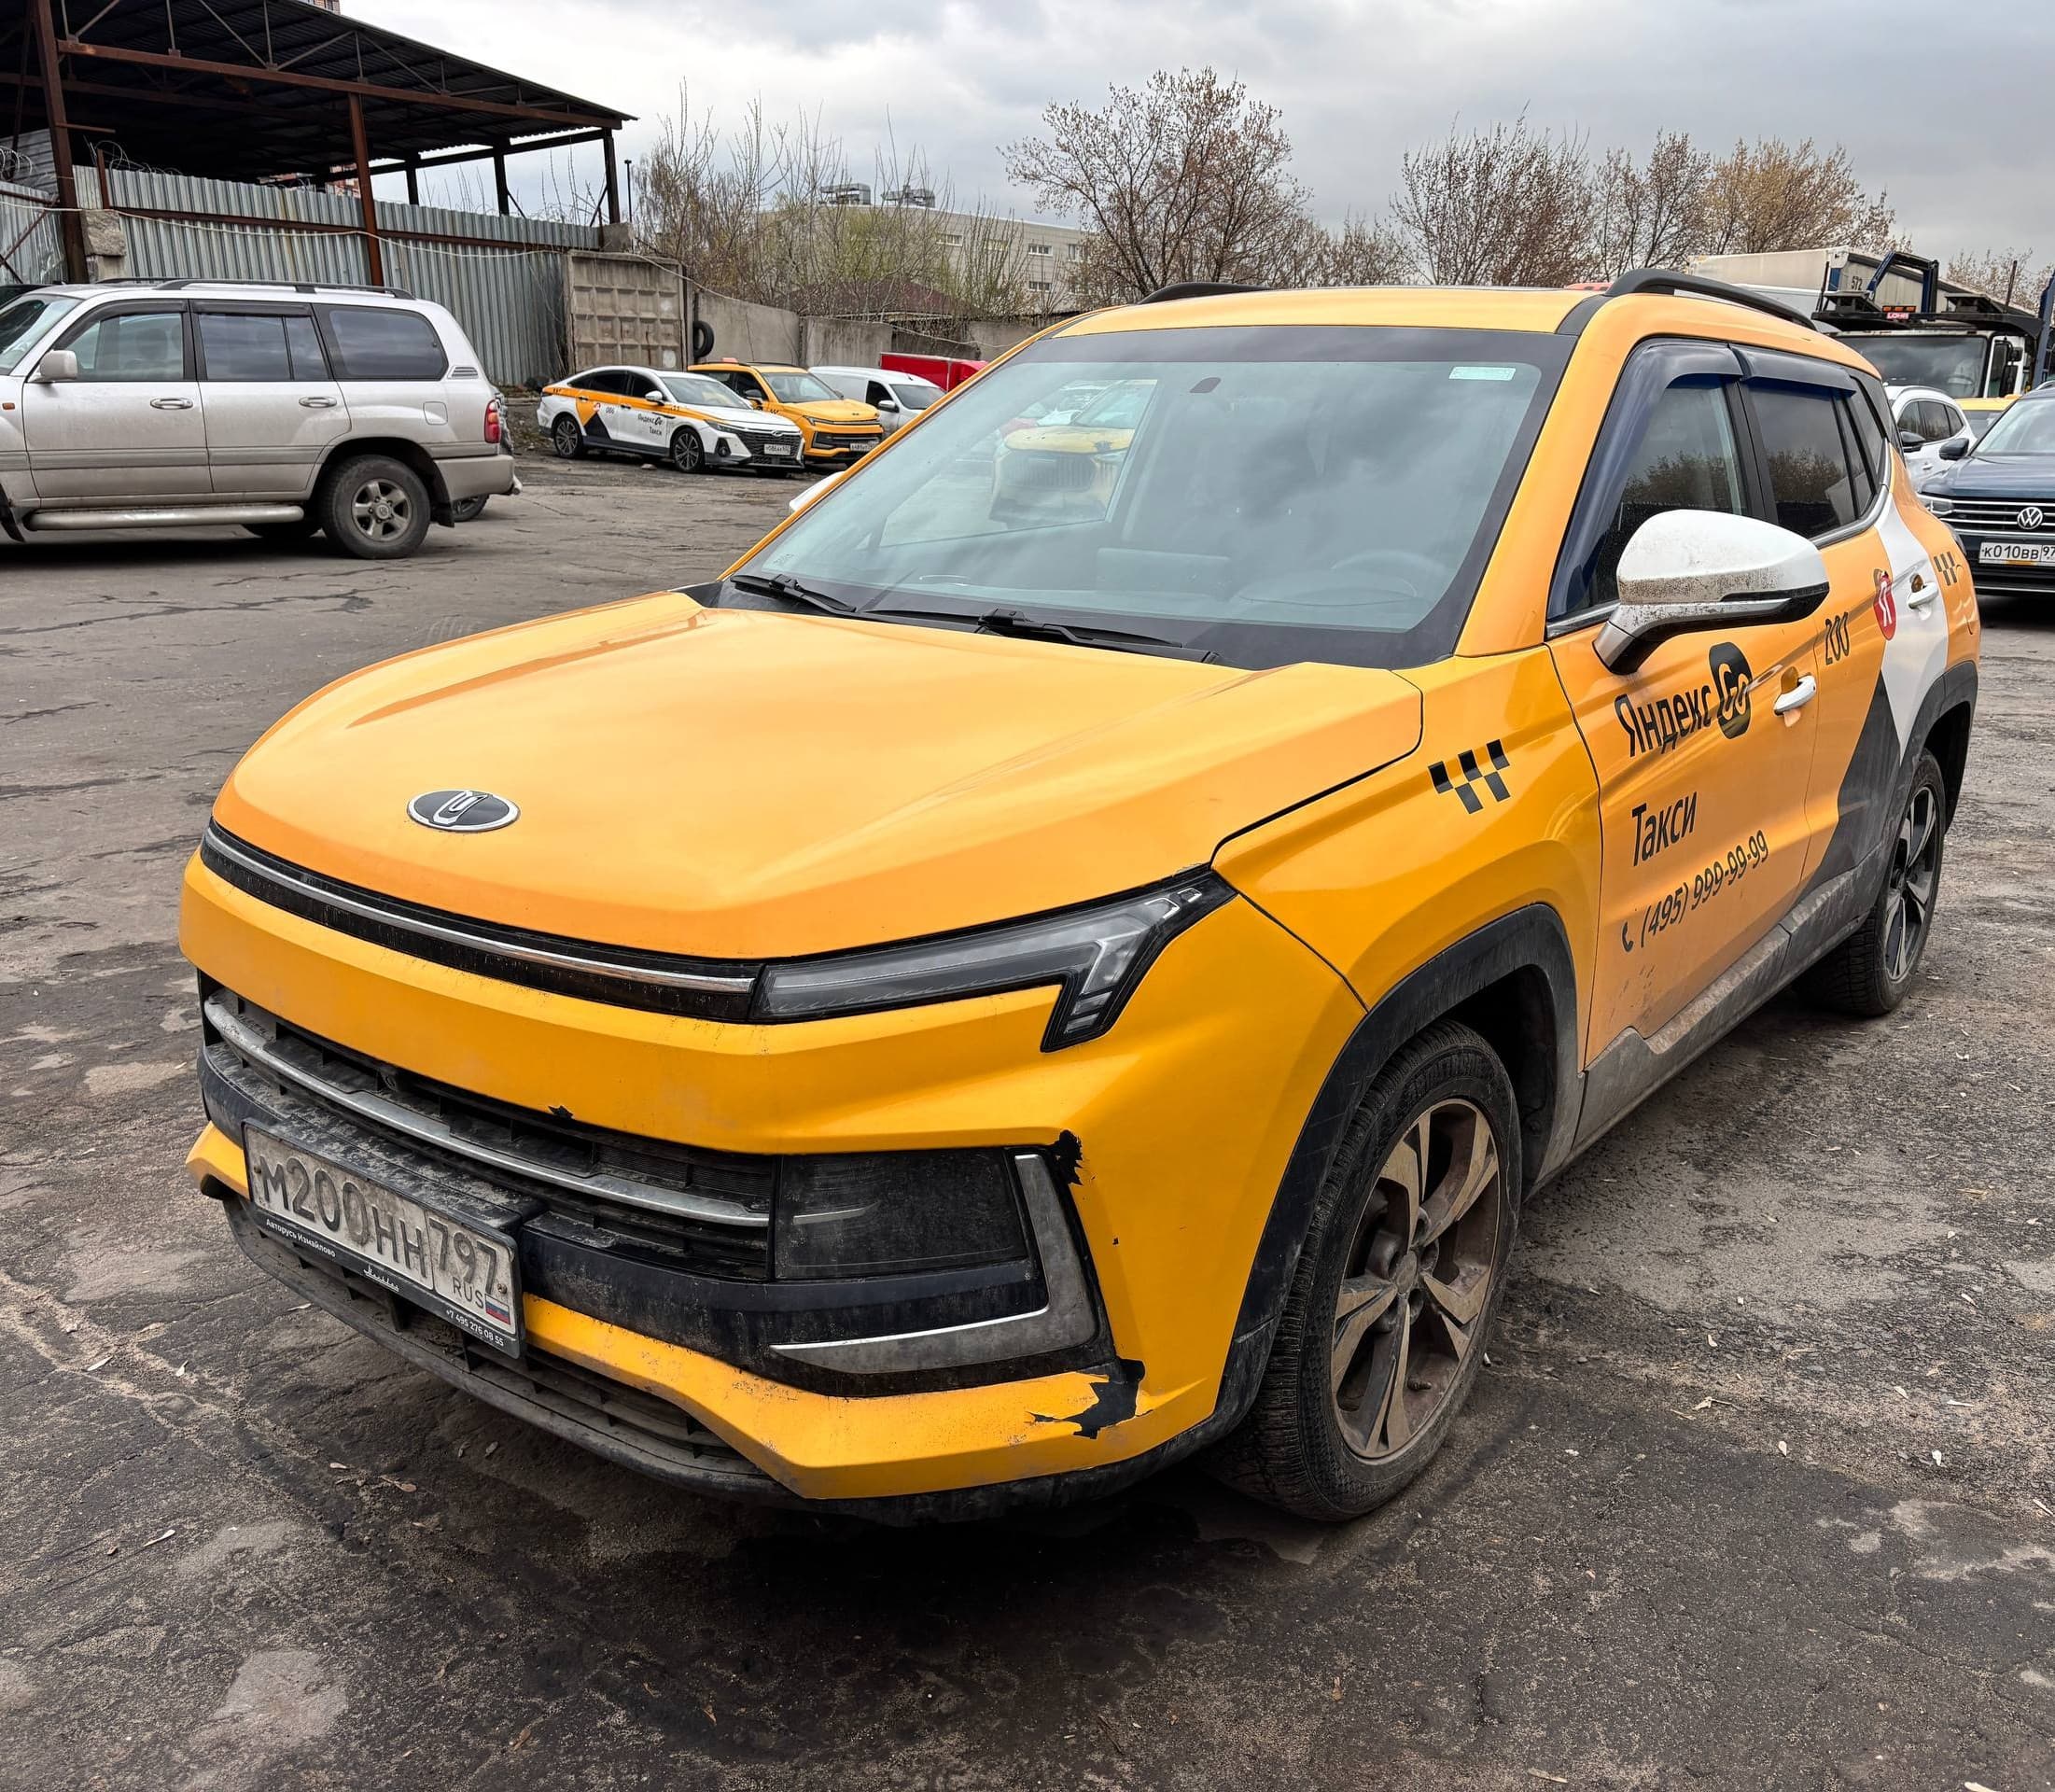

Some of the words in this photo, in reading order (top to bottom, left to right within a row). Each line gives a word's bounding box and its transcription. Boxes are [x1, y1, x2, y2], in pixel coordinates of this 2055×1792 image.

[1852, 276, 1863, 290] 572
[1984, 544, 2039, 560] К010ВВ
[1825, 611, 1850, 665] 200
[1614, 684, 1712, 758] Яндекс
[1632, 791, 1698, 867] Такси
[1641, 882, 1689, 948] (495)
[1691, 830, 1768, 911] 999-99-99
[259, 1154, 427, 1280] М200НН
[428, 1215, 497, 1295] 797
[266, 1218, 298, 1239] Авторусь
[298, 1232, 337, 1258] Измайлово
[452, 1276, 485, 1309] RUS
